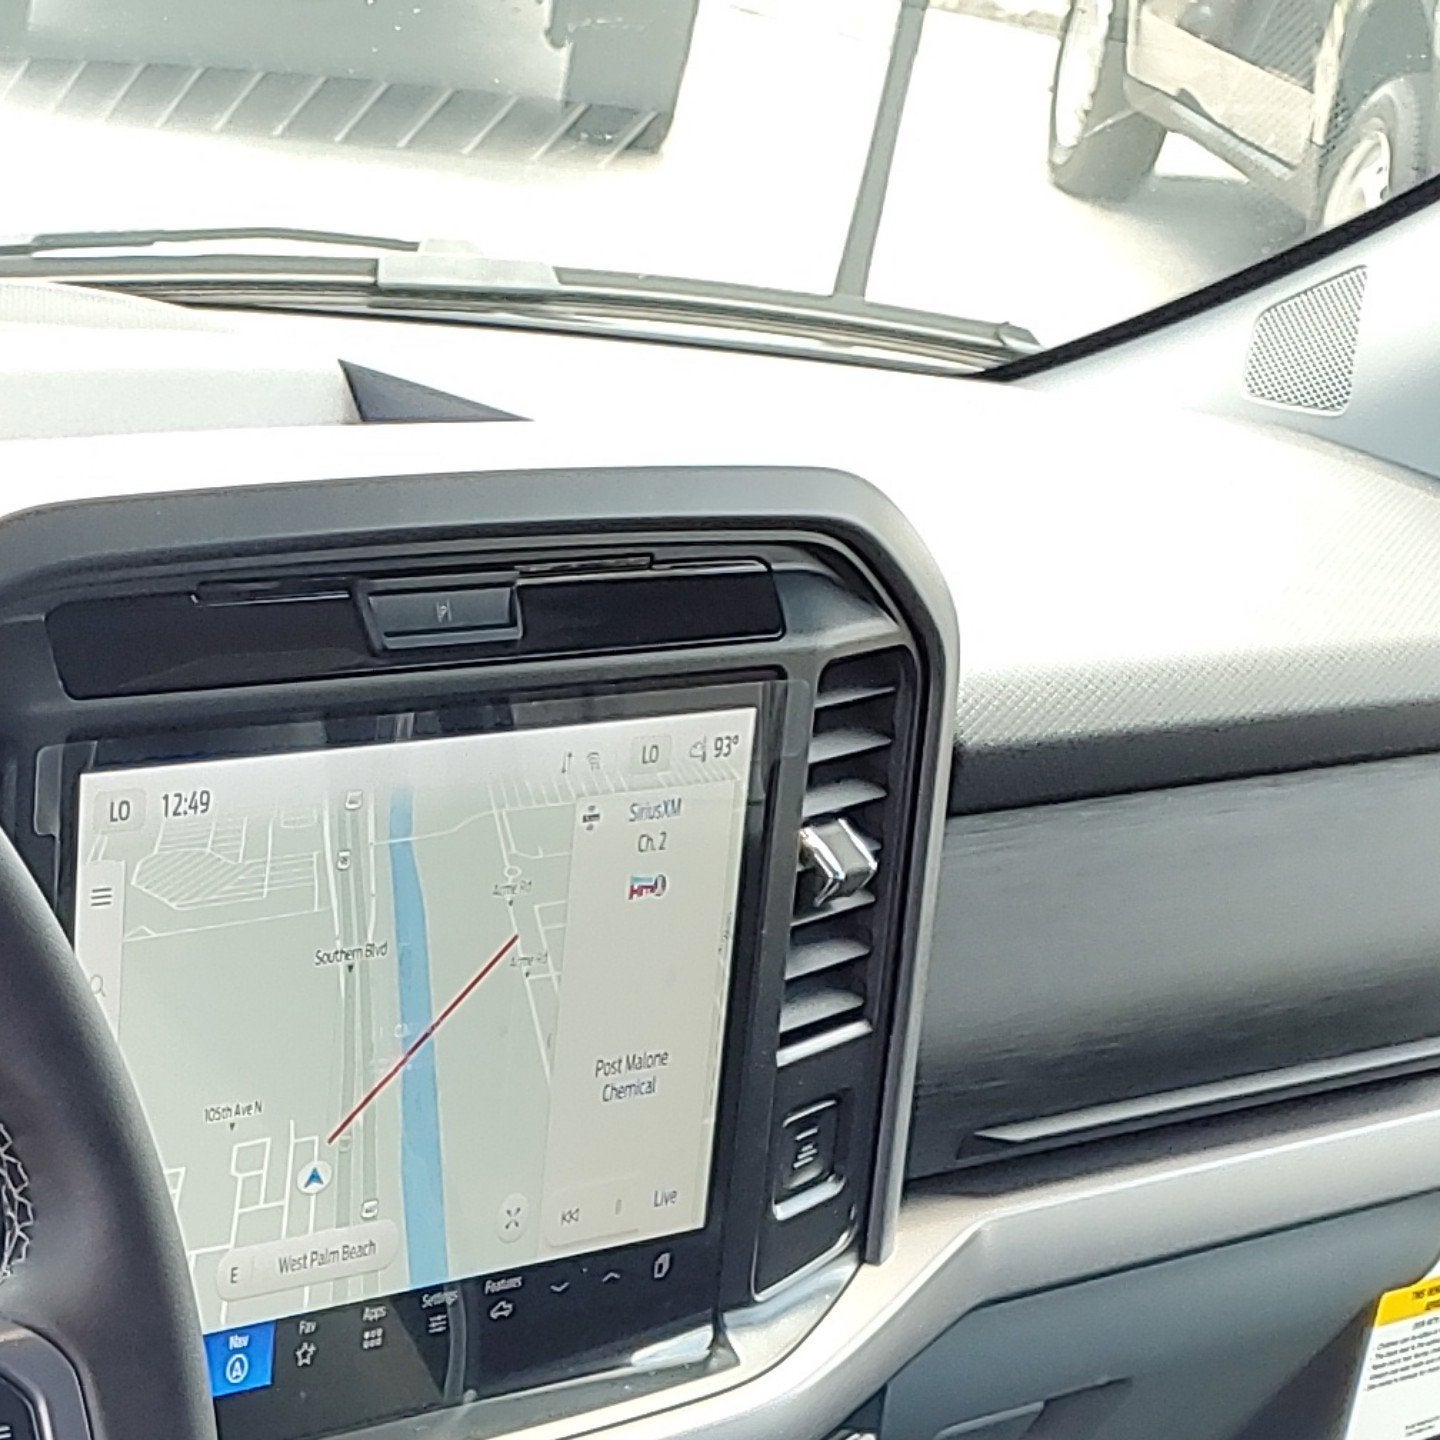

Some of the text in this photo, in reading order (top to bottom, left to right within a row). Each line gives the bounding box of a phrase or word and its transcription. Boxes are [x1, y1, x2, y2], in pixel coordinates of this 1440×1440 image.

[643, 746, 659, 764] LO
[109, 790, 210, 822] LO 12:49
[629, 799, 682, 822] SiriusXM
[595, 1049, 670, 1078] Post Malone
[602, 1077, 656, 1102] Chemical
[234, 1104, 253, 1120] Ave
[254, 1101, 263, 1115] N
[654, 1188, 678, 1208] Live
[278, 1239, 377, 1275] West Palm Beach
[231, 1266, 239, 1284] E
[362, 1305, 387, 1322] Apps
[299, 1319, 317, 1336] Fav
[228, 1332, 250, 1350] Nav
